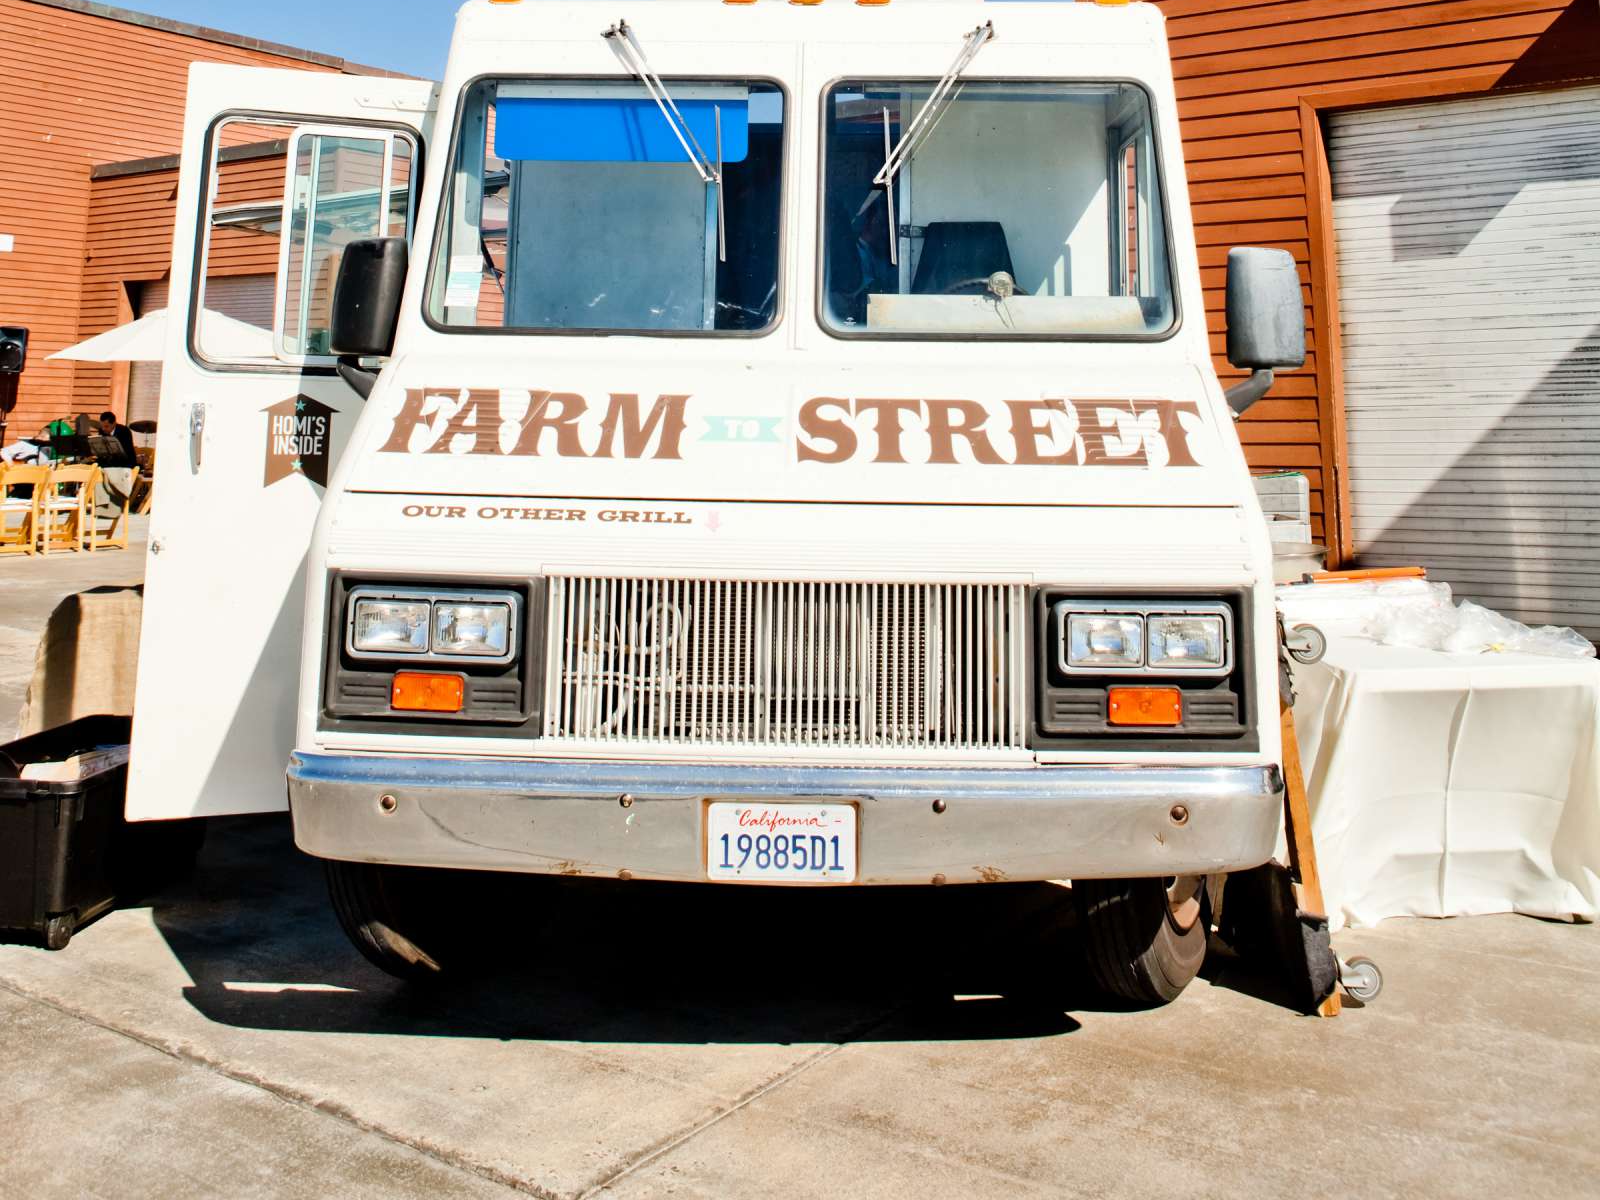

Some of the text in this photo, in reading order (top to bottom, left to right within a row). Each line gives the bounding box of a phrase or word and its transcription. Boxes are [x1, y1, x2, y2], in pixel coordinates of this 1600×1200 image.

[272, 415, 326, 435] HOMI'S
[376, 387, 1204, 467] FARM TO STREET
[273, 435, 323, 455] INSIDE
[402, 505, 692, 524] OUR OTHER GRILL
[739, 809, 828, 832] California
[720, 833, 844, 870] 19885D1
